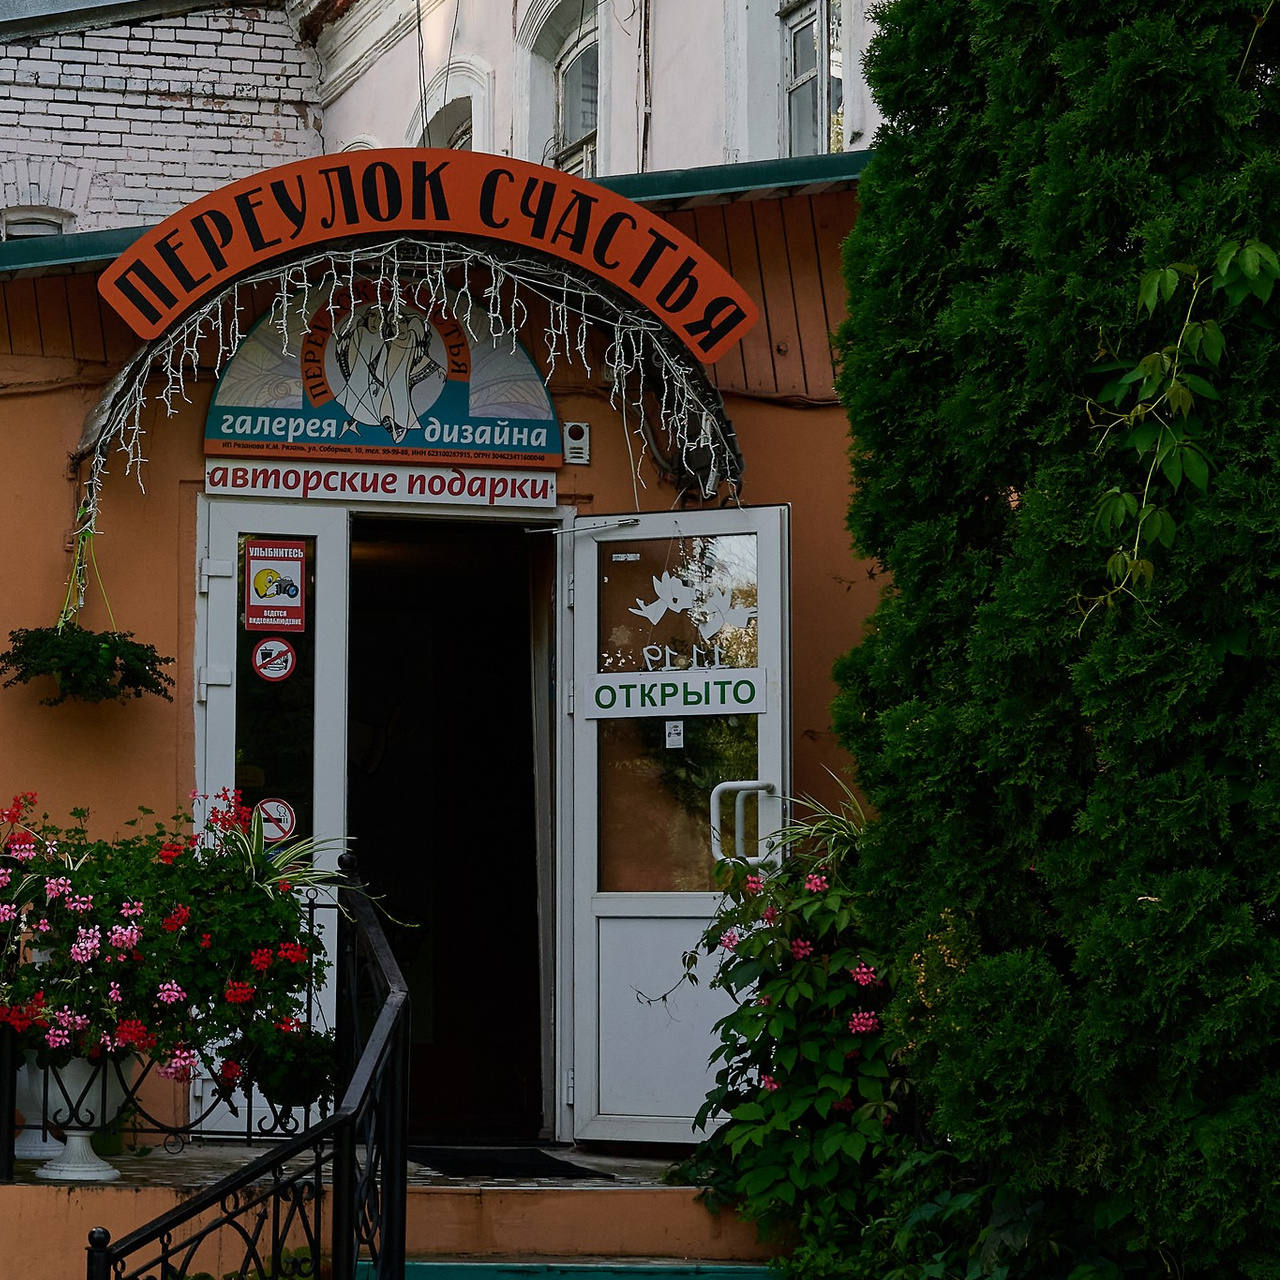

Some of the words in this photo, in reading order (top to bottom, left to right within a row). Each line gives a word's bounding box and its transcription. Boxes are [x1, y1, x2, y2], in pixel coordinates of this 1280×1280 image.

[113, 160, 450, 327] ПЕРЕУЛОК
[479, 168, 749, 354] СЧАСТЬЯ
[220, 414, 337, 443] галерея
[424, 416, 548, 447] дизайна
[427, 450, 473, 458] 623100287915,
[208, 465, 397, 499] авторские
[407, 468, 549, 505] подарки
[249, 547, 304, 558] УЛЫБНИТЕСЬ
[594, 678, 756, 709] ОТКРЫТО
